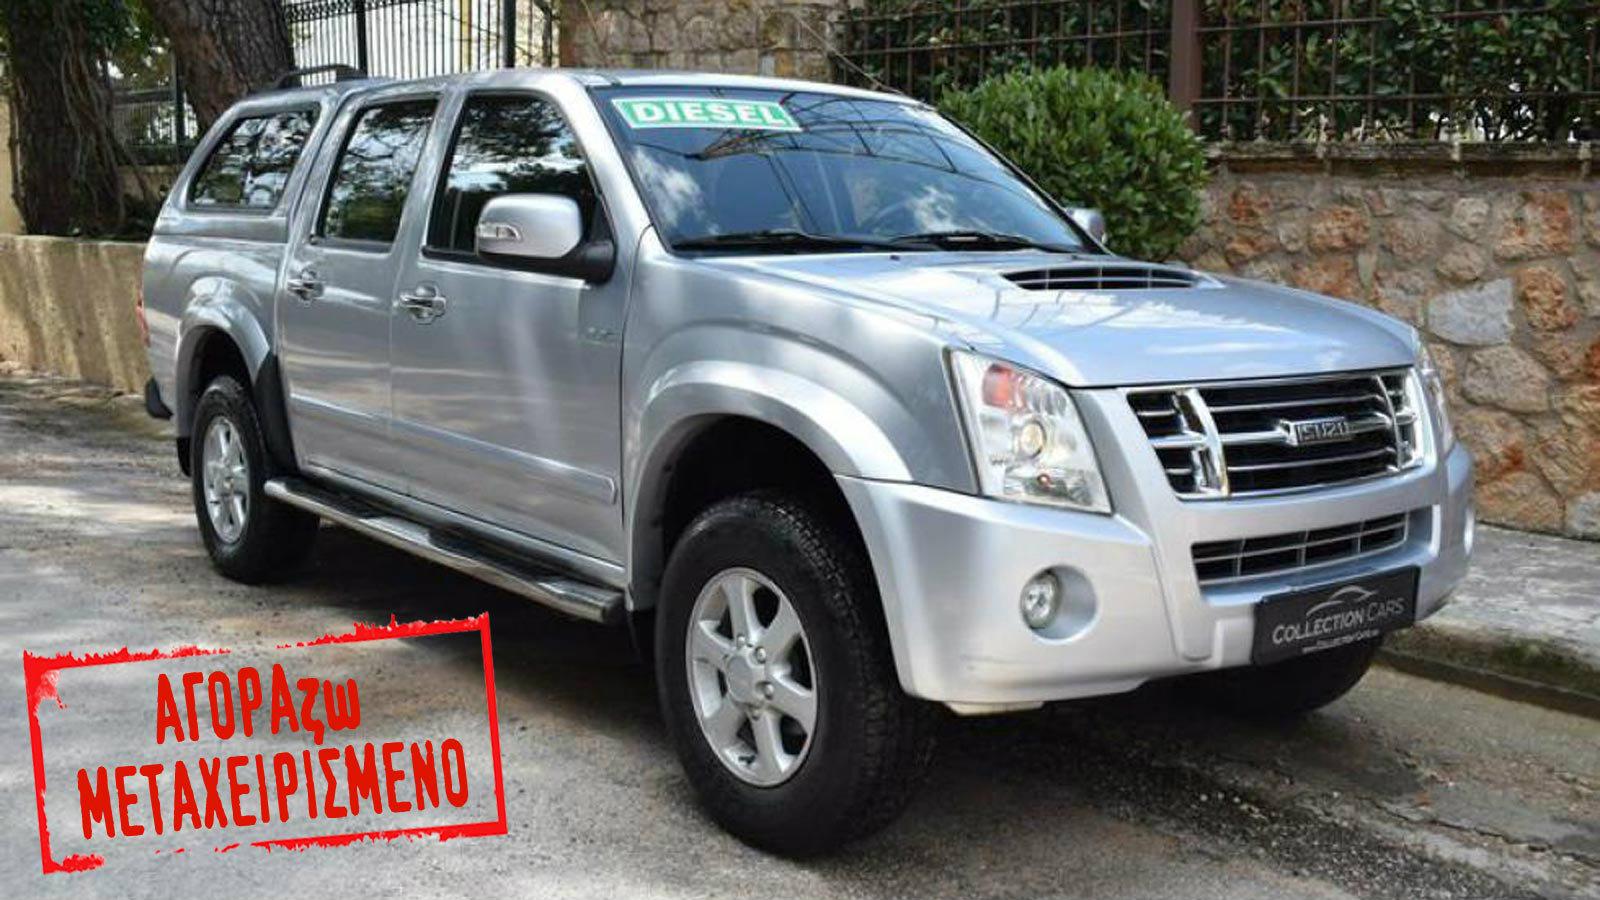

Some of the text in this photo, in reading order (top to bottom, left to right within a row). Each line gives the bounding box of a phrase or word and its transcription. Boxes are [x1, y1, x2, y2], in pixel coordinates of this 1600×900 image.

[633, 102, 787, 124] DIESEL
[1296, 420, 1349, 441] ISUZU
[1272, 610, 1365, 645] COLLECTION
[1367, 598, 1405, 622] CARS
